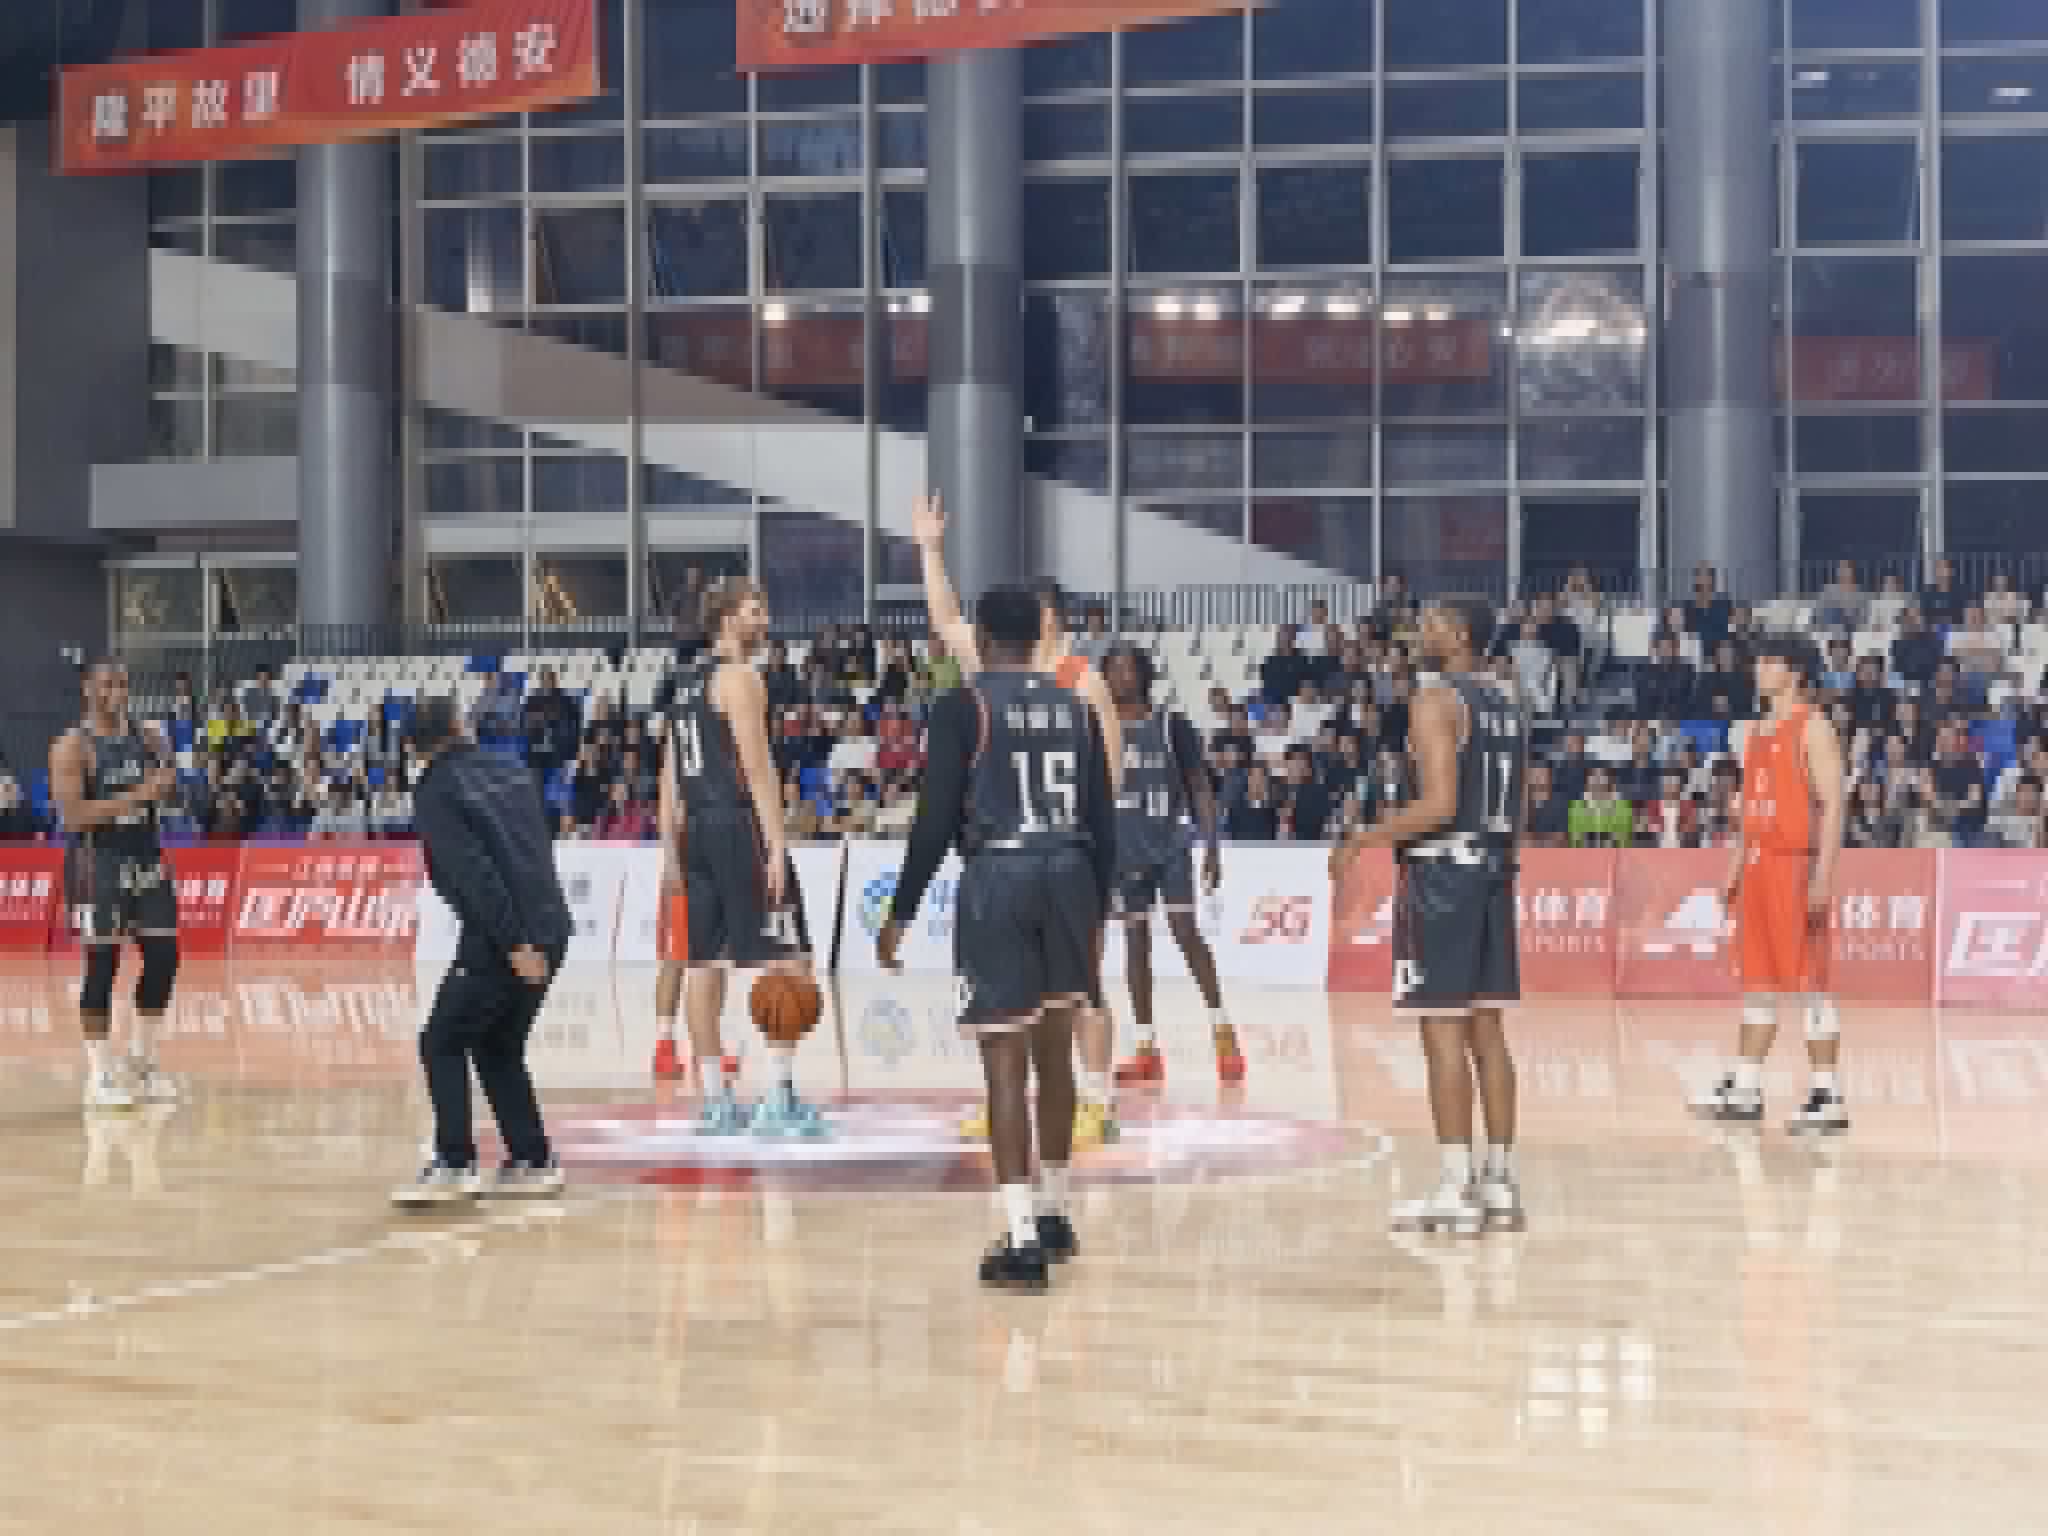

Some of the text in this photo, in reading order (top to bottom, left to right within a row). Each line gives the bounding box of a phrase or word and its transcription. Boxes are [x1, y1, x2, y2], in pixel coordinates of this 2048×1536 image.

[344, 23, 560, 105] 情义德安
[1009, 750, 1078, 833] 15
